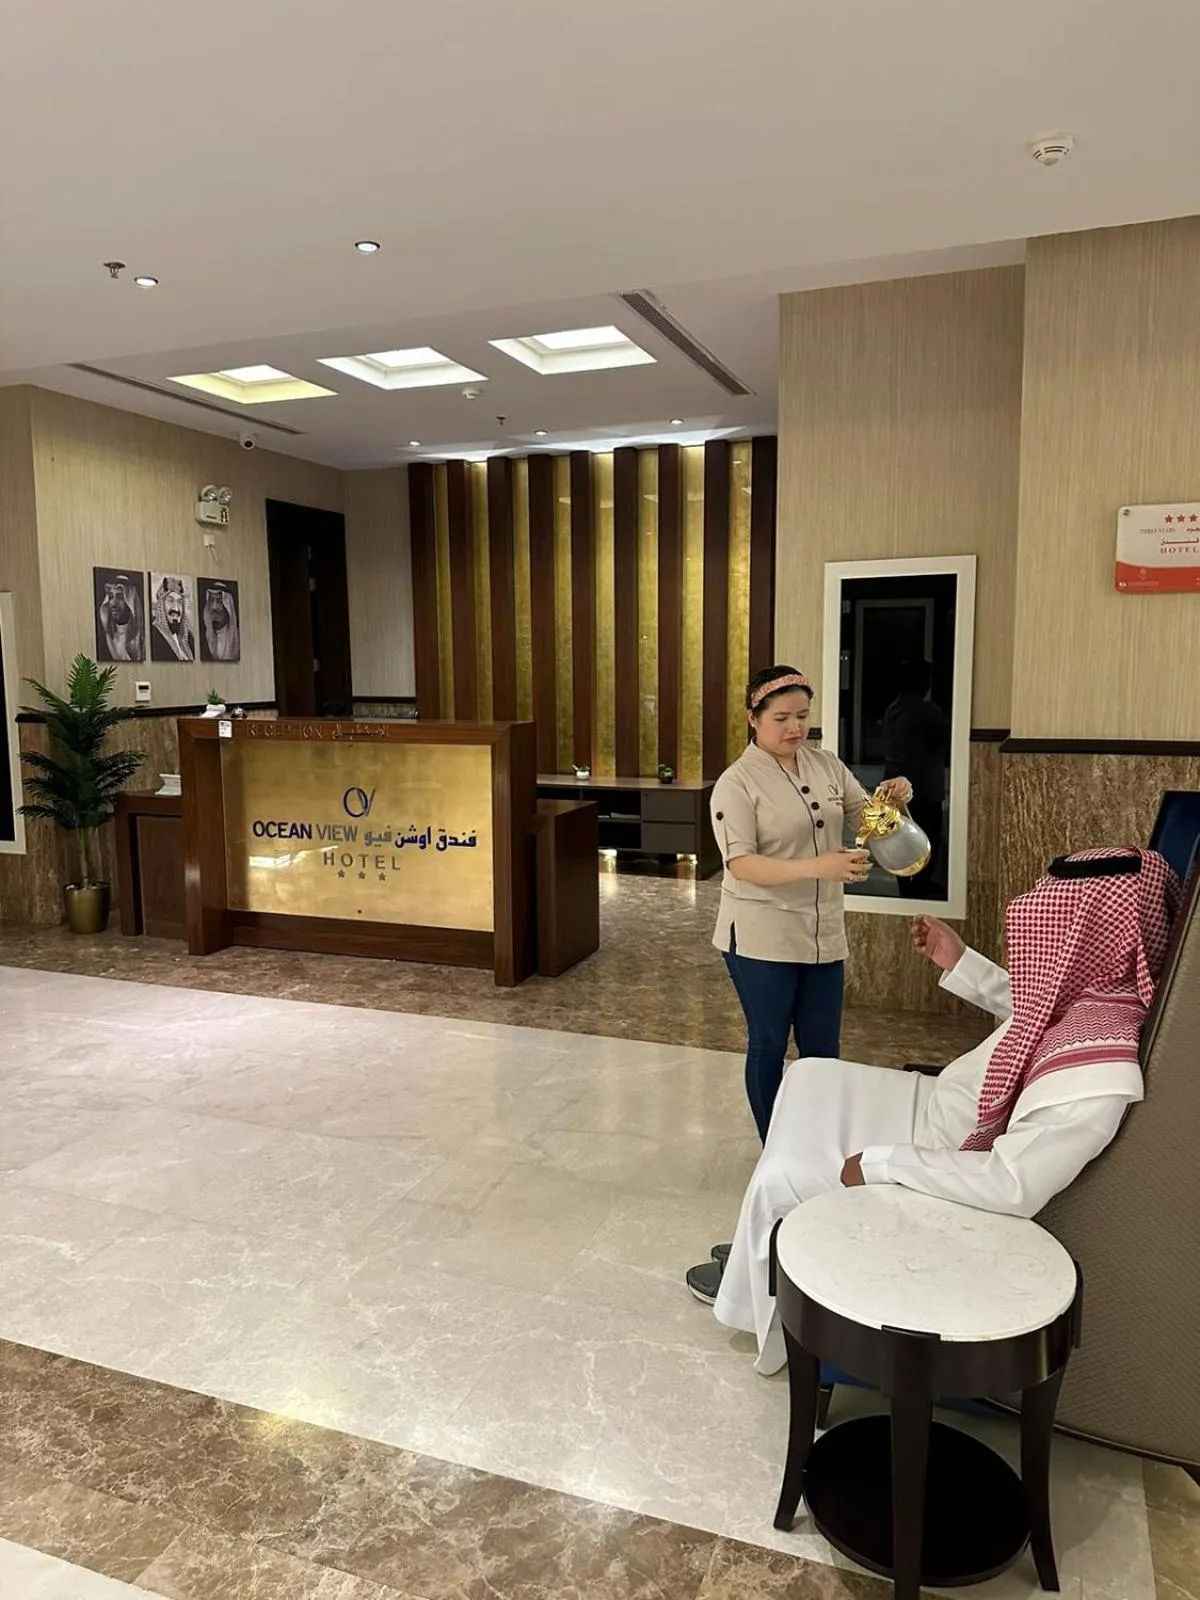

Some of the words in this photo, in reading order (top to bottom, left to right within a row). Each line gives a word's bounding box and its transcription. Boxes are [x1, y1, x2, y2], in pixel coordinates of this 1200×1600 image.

[1161, 546, 1199, 554] HOTEL
[252, 820, 313, 840] OCEAN
[315, 824, 359, 842] VIEW
[364, 825, 393, 848] فيو
[435, 828, 478, 852] فندق
[323, 851, 401, 871] HOTEL
